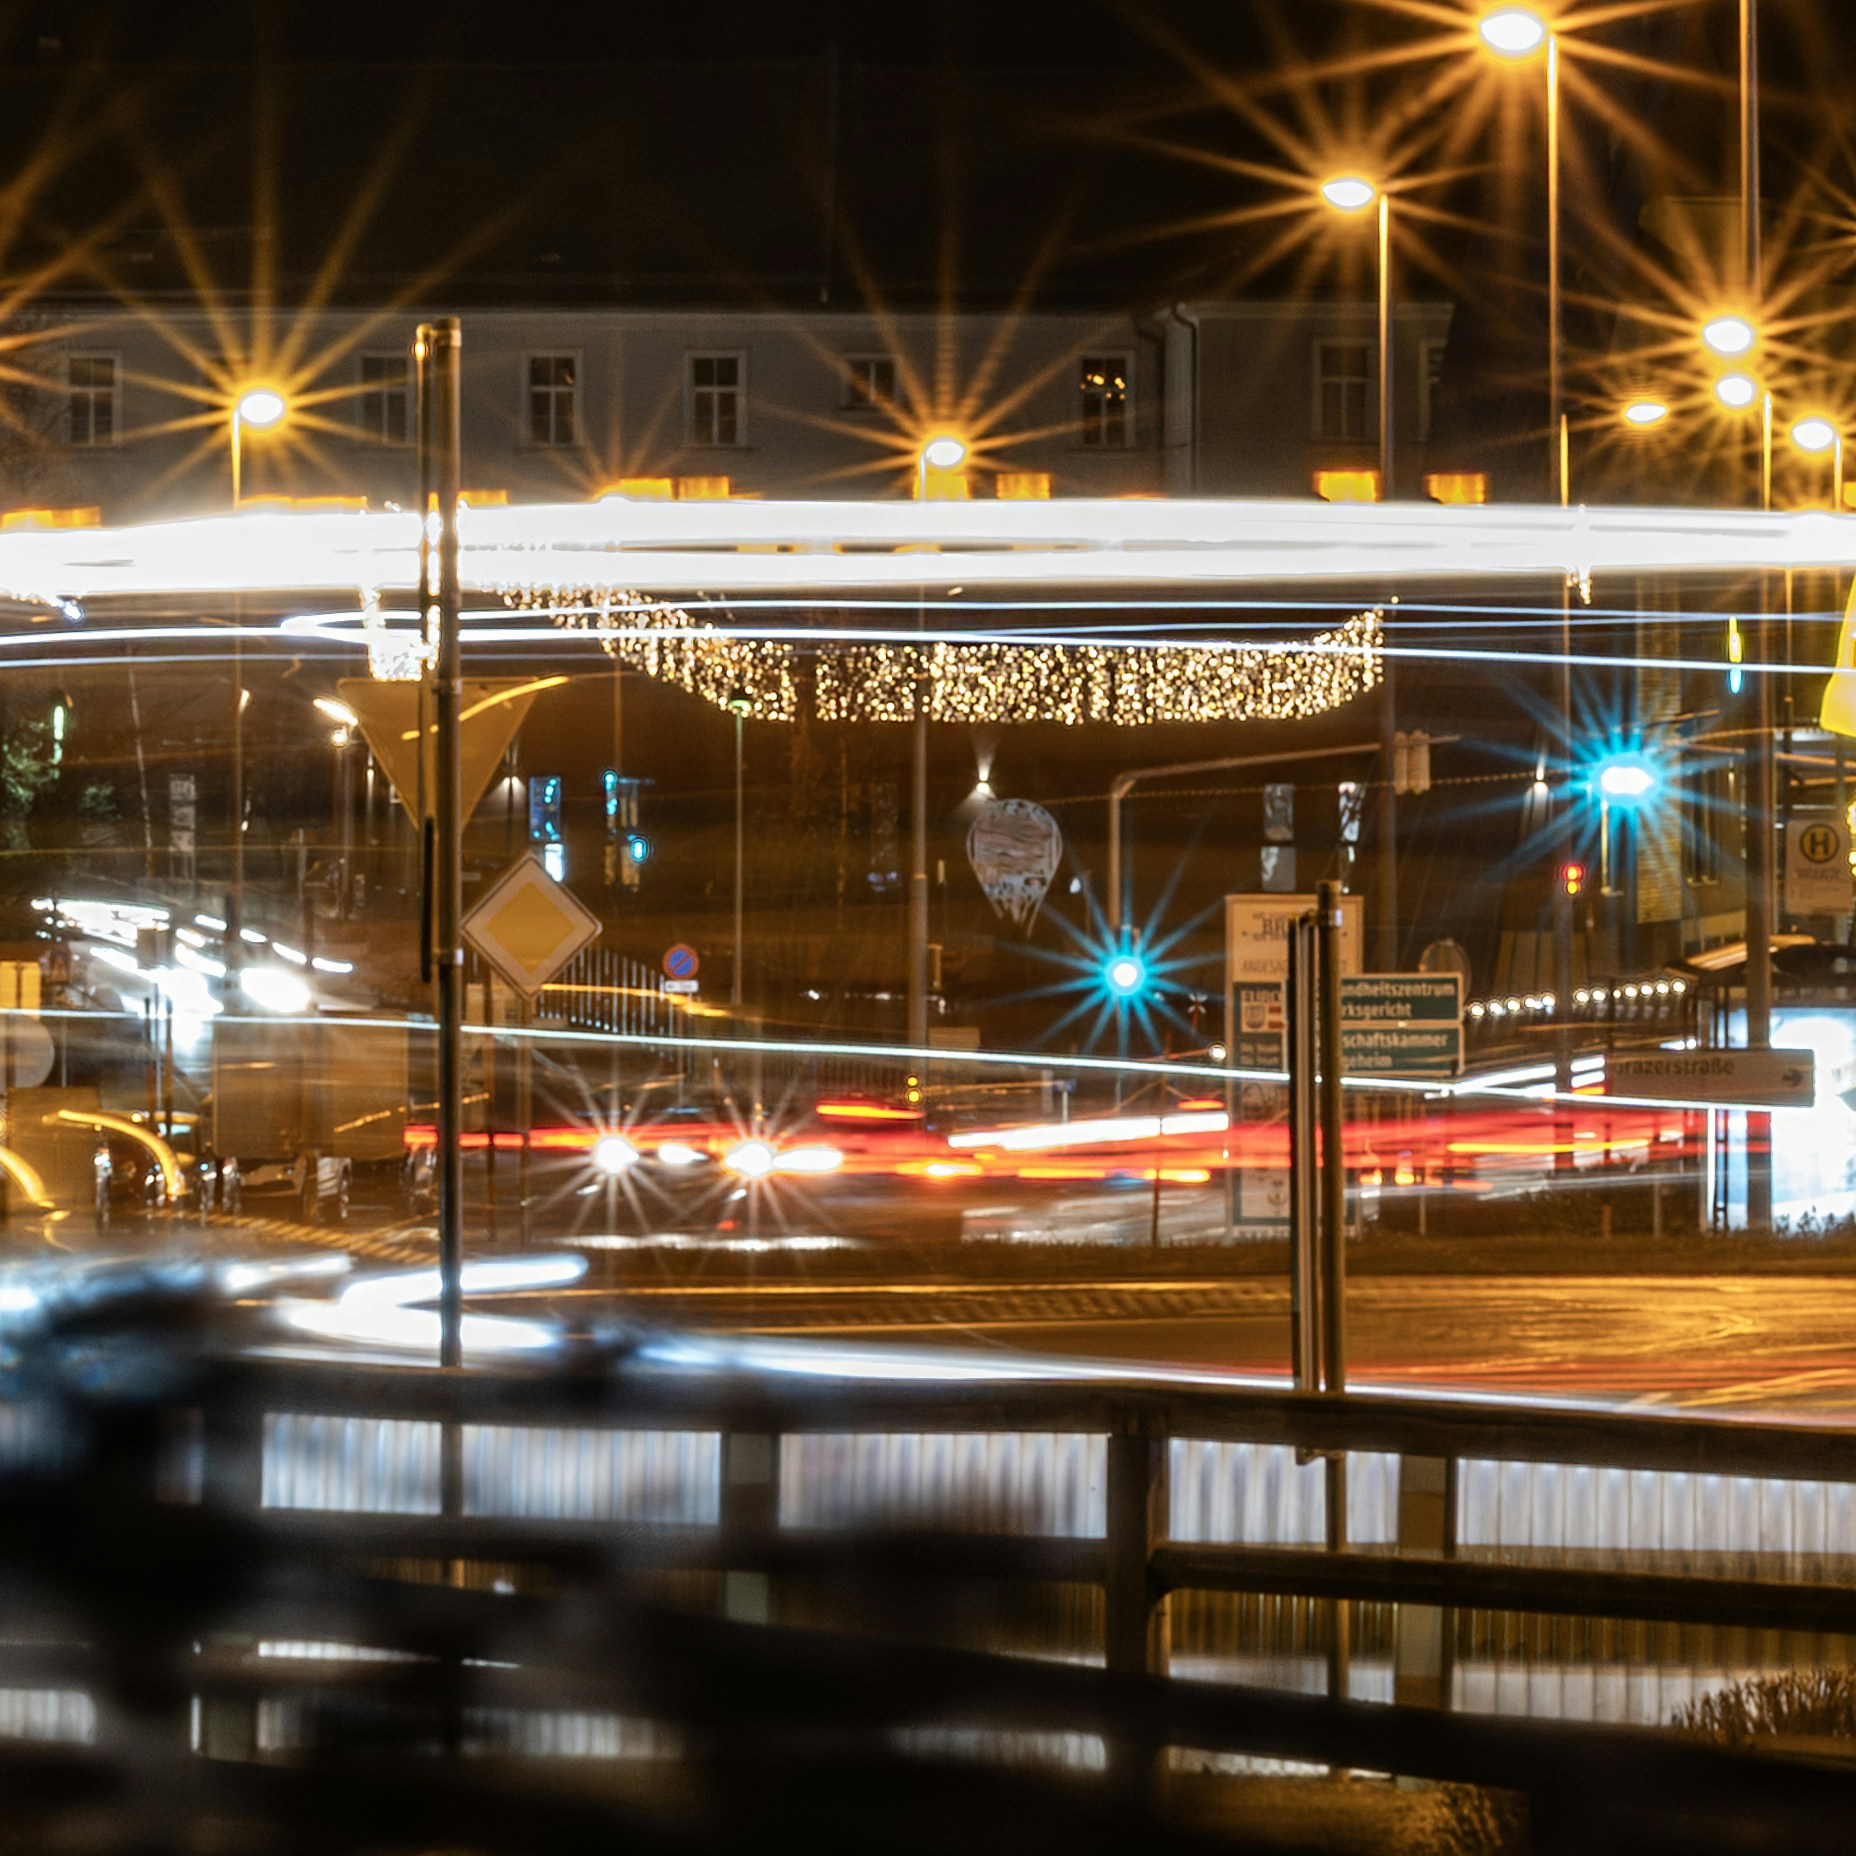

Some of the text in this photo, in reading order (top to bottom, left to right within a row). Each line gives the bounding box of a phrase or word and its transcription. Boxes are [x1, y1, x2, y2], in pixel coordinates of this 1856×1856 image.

[1810, 831, 1833, 857] H
[1342, 1001, 1413, 1020] rksgericht
[1342, 1032, 1448, 1049] schaftskammer
